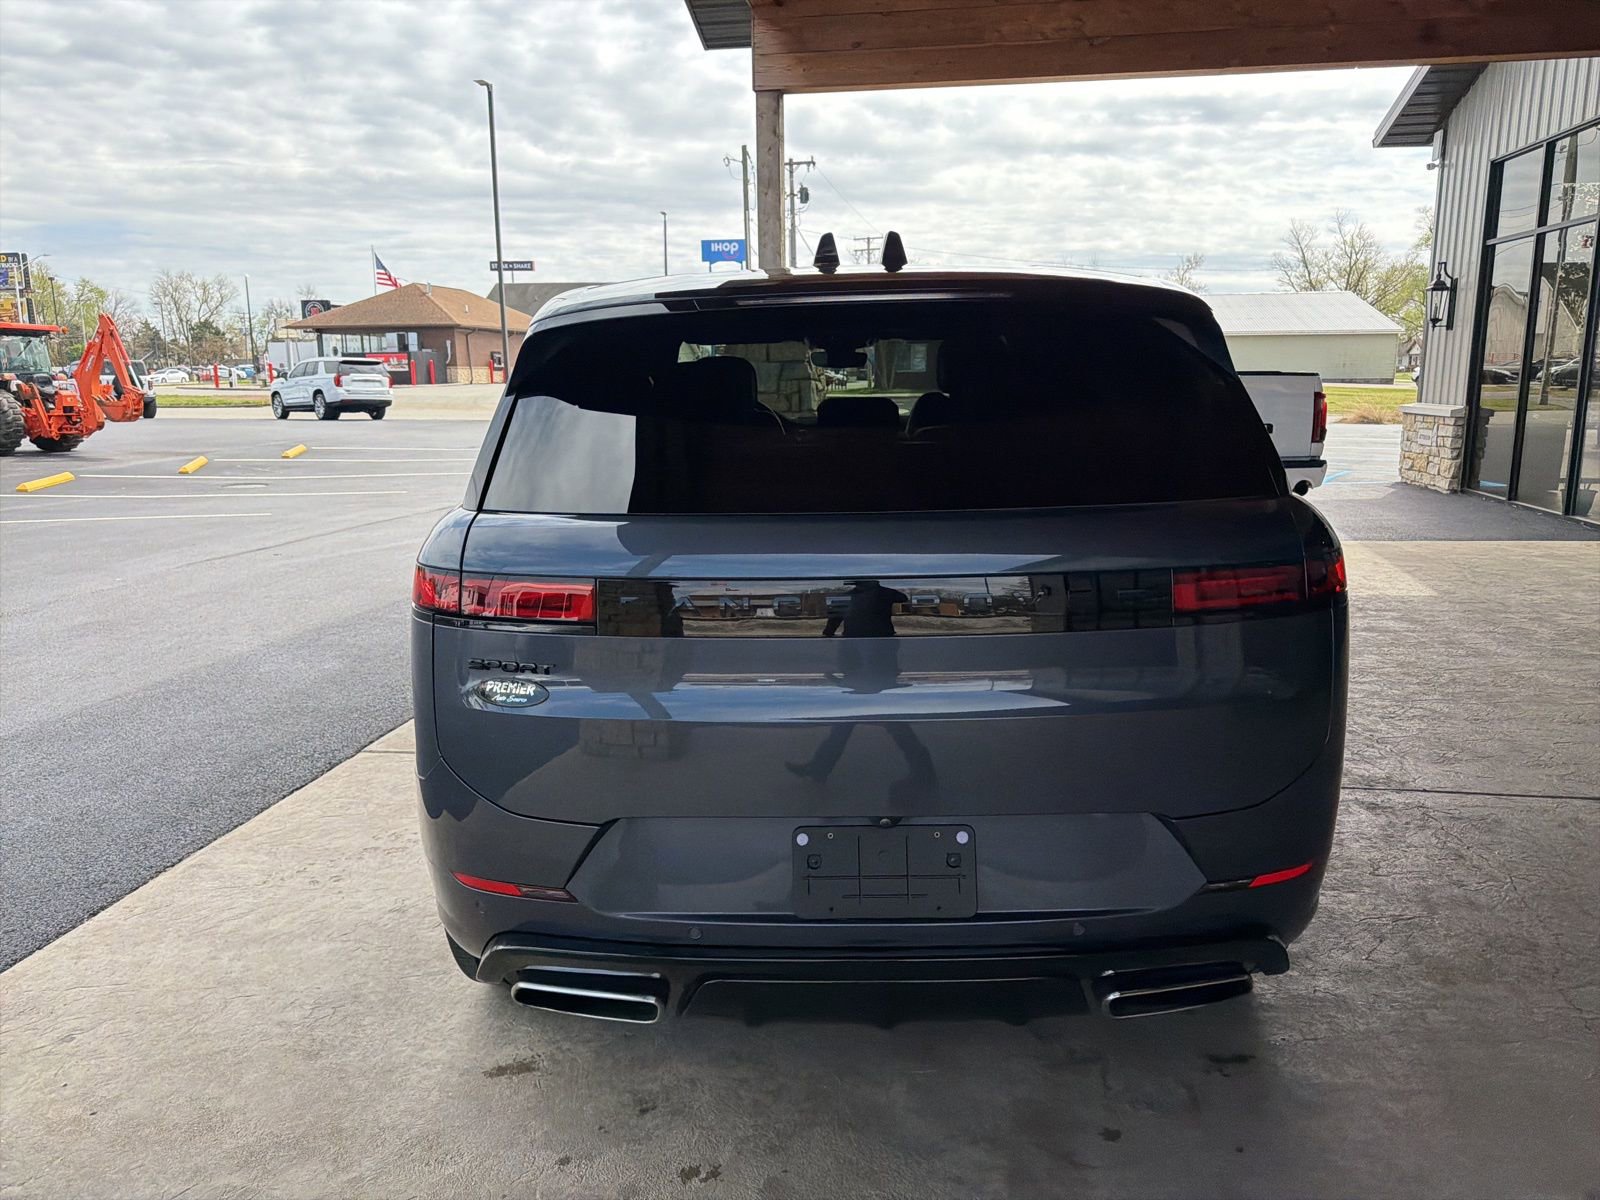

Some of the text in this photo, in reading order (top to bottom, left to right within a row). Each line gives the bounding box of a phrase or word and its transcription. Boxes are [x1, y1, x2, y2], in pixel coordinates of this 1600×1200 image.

[711, 242, 738, 254] IHOP
[468, 658, 556, 675] SPORT
[486, 680, 536, 696] PREMIER
